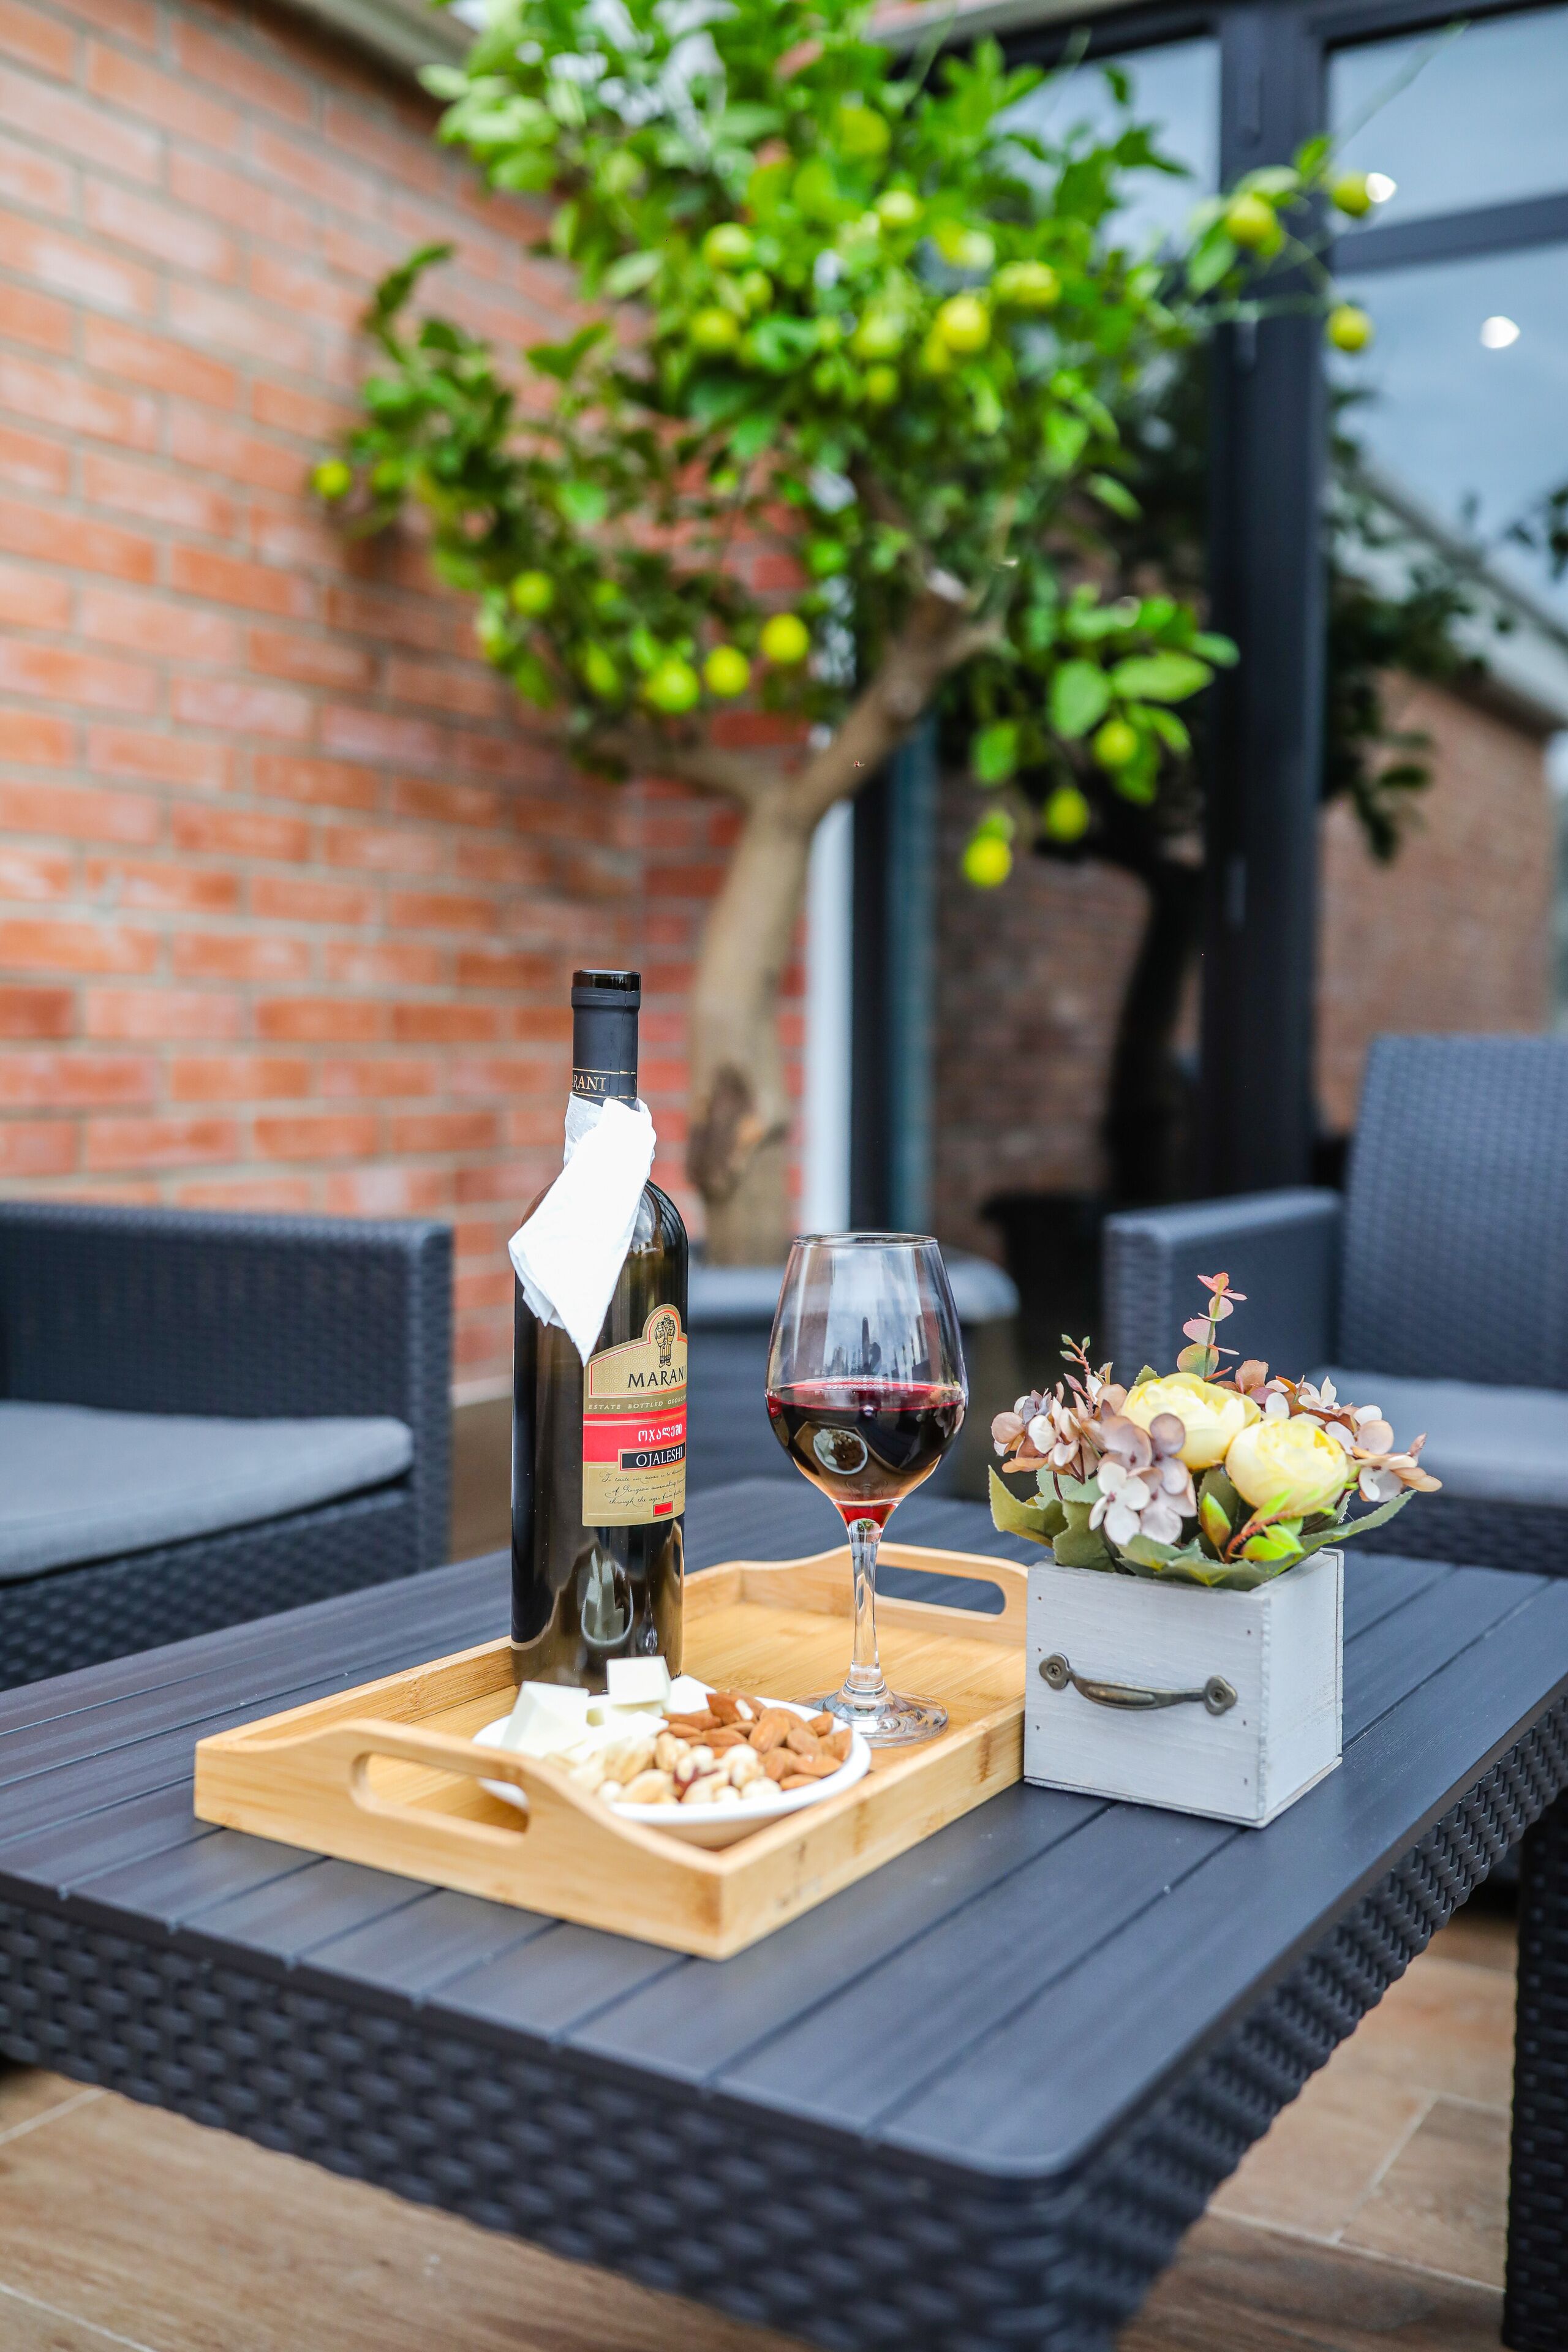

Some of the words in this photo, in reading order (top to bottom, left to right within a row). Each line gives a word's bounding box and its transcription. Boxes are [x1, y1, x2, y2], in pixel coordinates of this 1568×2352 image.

[627, 1365, 686, 1388] MARANI
[628, 1401, 663, 1409] BOTTLED
[636, 1446, 682, 1467] OJALESHI
[624, 1485, 649, 1494] Georgian
[609, 1496, 634, 1507] through
